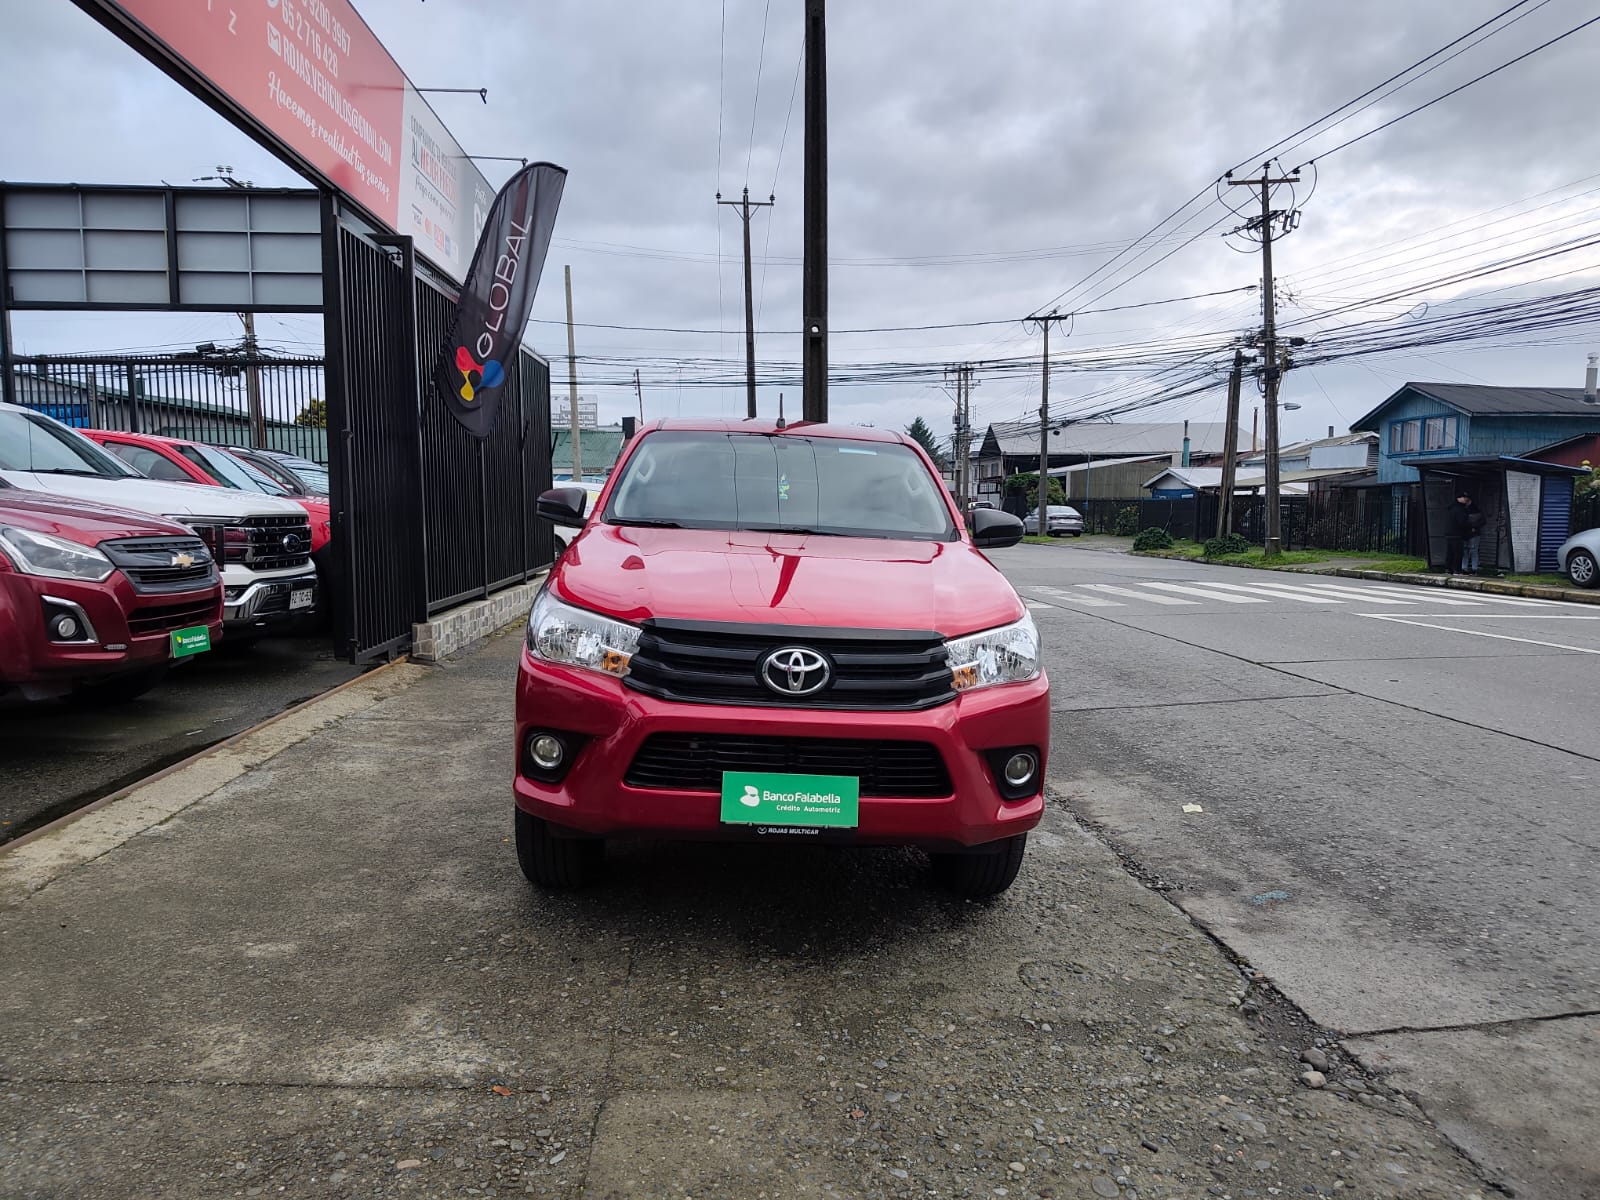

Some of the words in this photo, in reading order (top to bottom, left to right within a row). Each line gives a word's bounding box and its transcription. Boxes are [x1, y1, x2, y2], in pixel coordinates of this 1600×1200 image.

[332, 16, 350, 56] 3967
[268, 71, 318, 138] Hacemos
[318, 124, 354, 167] realidad
[283, 35, 391, 167] ROJAS.VEHICULOS@GMAIL.COM
[412, 135, 419, 165] AL
[477, 215, 533, 358] GLOBAL
[776, 804, 800, 812] Crédito
